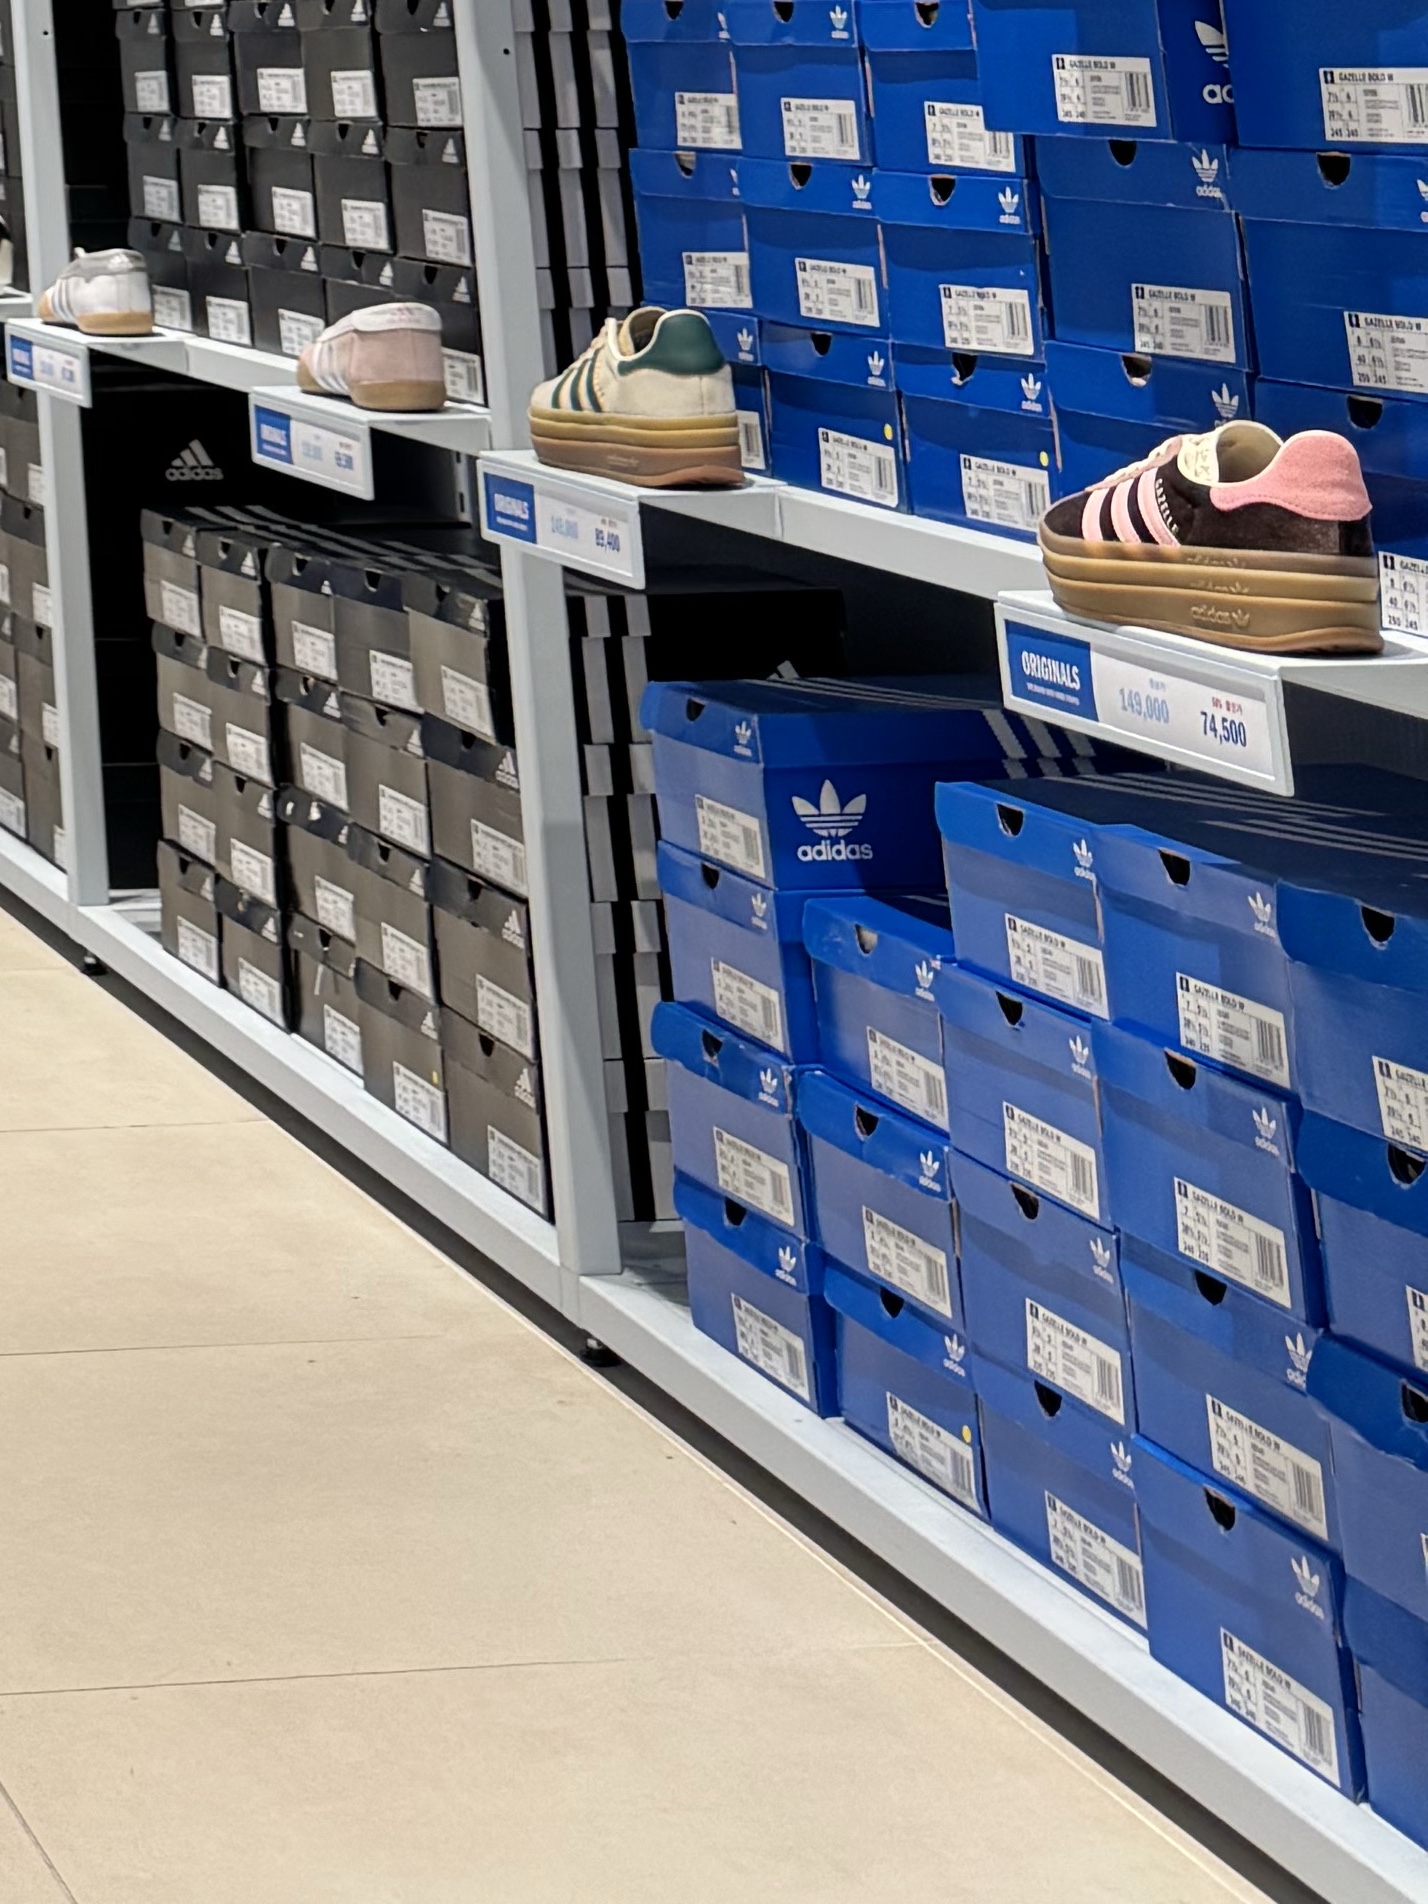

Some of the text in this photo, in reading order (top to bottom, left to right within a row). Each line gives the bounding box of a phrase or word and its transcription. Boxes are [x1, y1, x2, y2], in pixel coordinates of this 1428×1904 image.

[1339, 72, 1366, 83] GAZELLE
[1368, 73, 1385, 82] BOLD
[1148, 289, 1170, 301] GAZELLE
[1172, 291, 1189, 301] BOLD
[1364, 317, 1393, 330] GAZELLE
[1395, 320, 1414, 331] BOLD
[165, 468, 224, 481] adidas
[1154, 478, 1180, 535] GAZELLE
[1190, 604, 1230, 625] adidas
[1021, 651, 1081, 691] ORIGINALS
[1119, 687, 1170, 724] 149,000
[1200, 711, 1247, 748] 74,500
[797, 840, 873, 862] adidas
[1194, 980, 1218, 1001] GAZELLE
[1220, 993, 1237, 1009] BOLD
[1193, 1190, 1218, 1211] GAZELLE
[1220, 1205, 1236, 1221] BOLD
[1227, 1410, 1254, 1435] GAZELLE
[1255, 1427, 1273, 1448] BOLD
